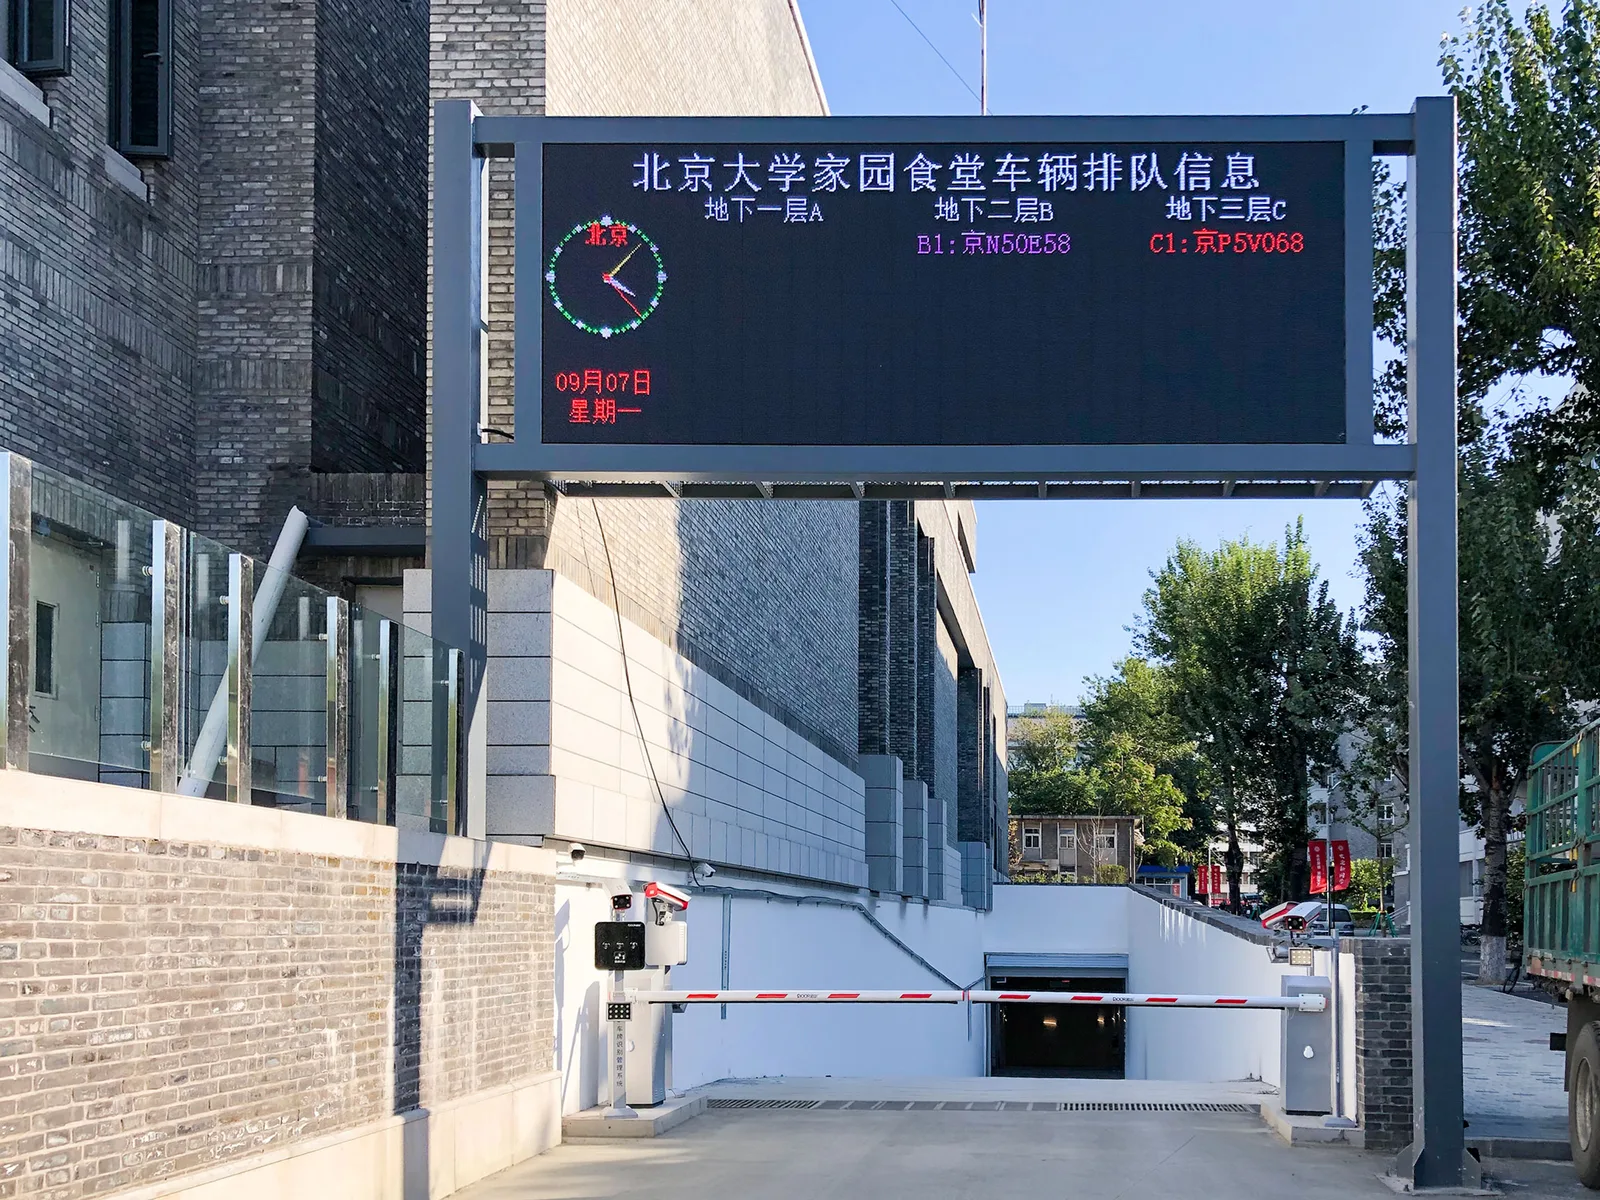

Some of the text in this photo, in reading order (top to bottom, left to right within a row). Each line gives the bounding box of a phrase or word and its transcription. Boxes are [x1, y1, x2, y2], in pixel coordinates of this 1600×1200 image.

[632, 152, 1260, 193] 北京大学家园食堂车辆排队信息
[704, 196, 824, 223] 地下一层A
[934, 195, 1054, 223] 地下二层B
[1165, 195, 1287, 223] 地下三层C
[584, 222, 629, 247] 北京
[1149, 228, 1305, 255] C1:京P5V068
[555, 369, 652, 396] 09月07日
[568, 398, 642, 425] 星期一
